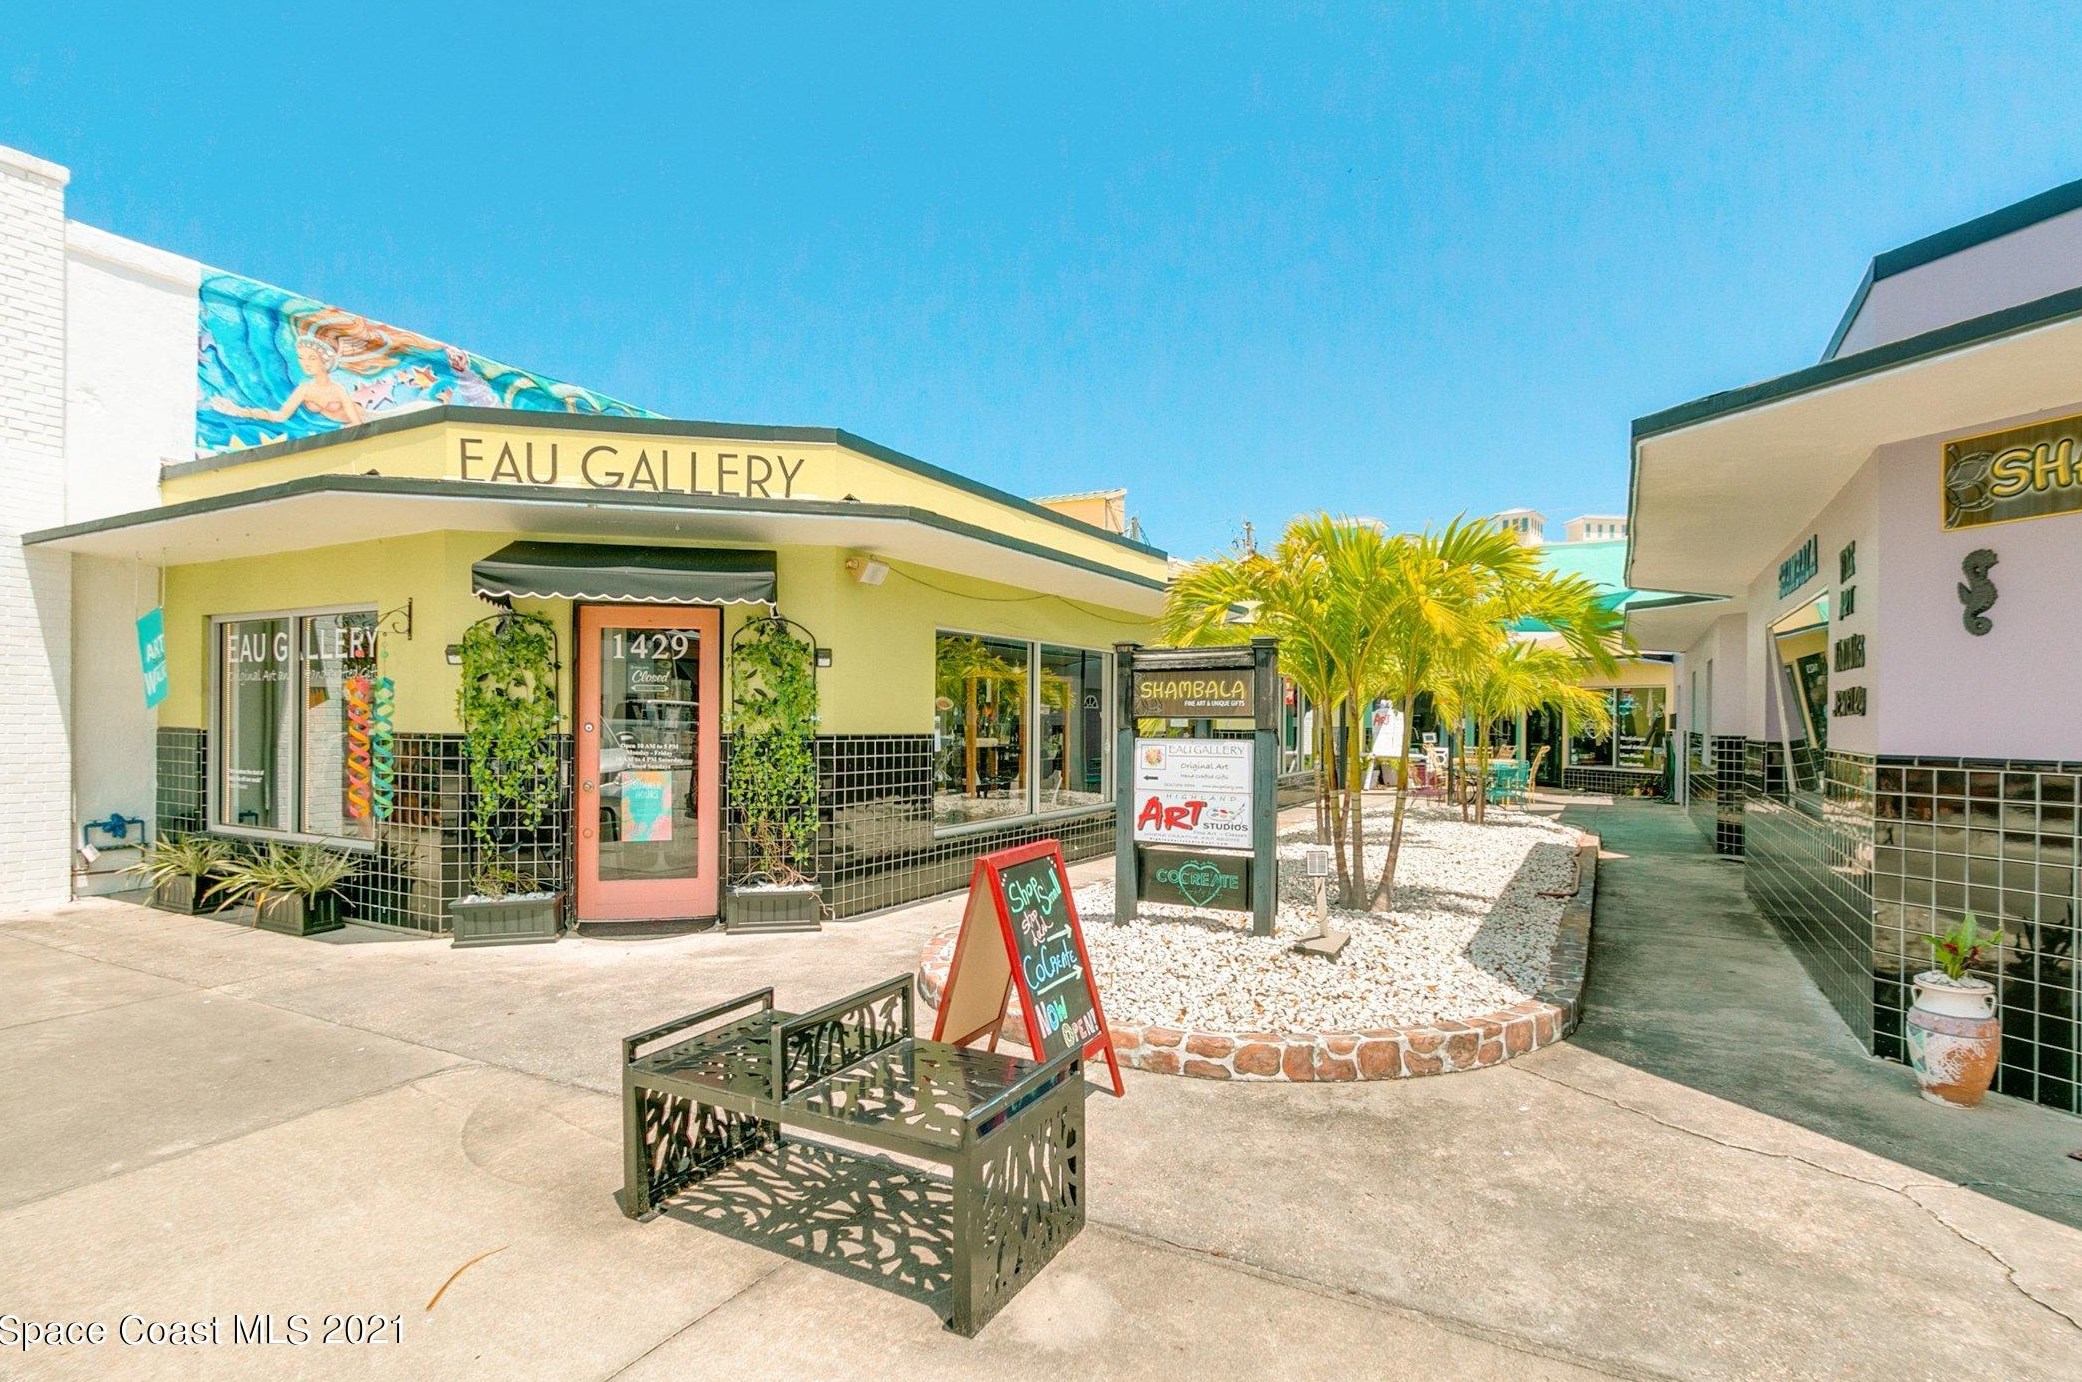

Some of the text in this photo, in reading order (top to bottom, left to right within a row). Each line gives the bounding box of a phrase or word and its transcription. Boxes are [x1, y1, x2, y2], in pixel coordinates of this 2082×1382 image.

[459, 438, 805, 499] EAU GALLERY
[1991, 438, 2082, 498] SH
[229, 633, 266, 663] EAU
[613, 634, 689, 660] 1429
[632, 669, 671, 683] Closed
[1140, 680, 1245, 699] SHAMBALA
[1193, 745, 1244, 755] GALLERY
[1181, 763, 1213, 771] Original
[1138, 796, 1208, 831] ART
[1203, 822, 1248, 831] STUDIOS
[1009, 868, 1061, 915] Shop Small
[1156, 869, 1239, 890] COCREATE
[1035, 995, 1068, 1039] NOW
[1061, 1007, 1099, 1048] OPEN!
